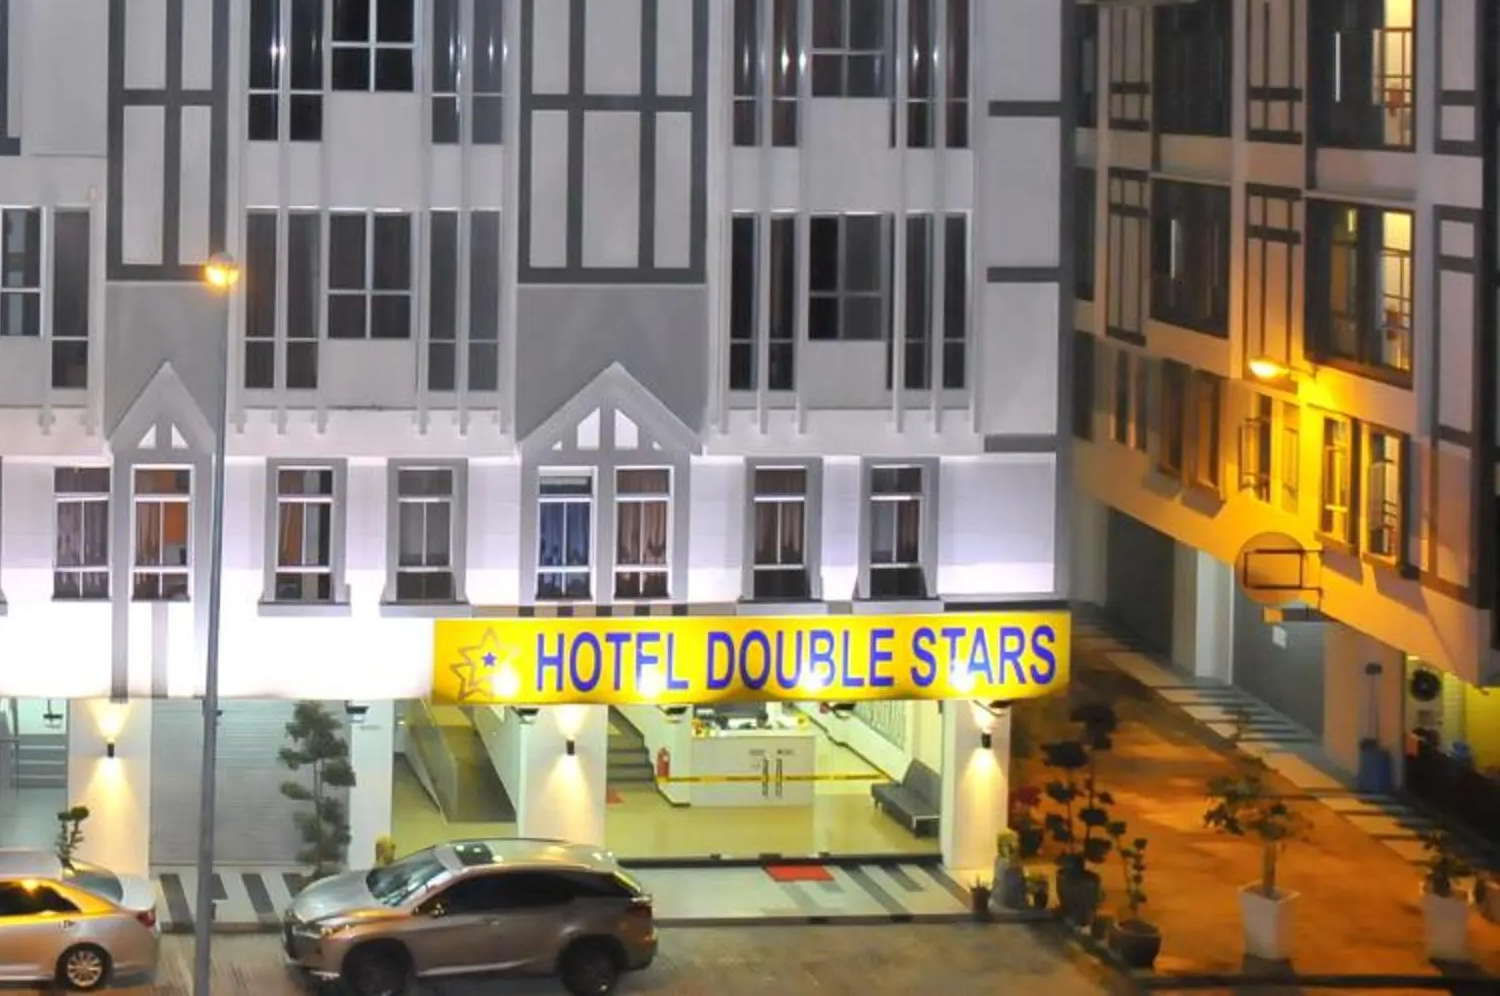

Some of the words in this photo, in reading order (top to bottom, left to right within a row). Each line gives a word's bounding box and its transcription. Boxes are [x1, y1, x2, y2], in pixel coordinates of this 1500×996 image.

[536, 631, 690, 693] HOTEL
[706, 628, 896, 691] DOUBLE
[909, 624, 1057, 688] STARS
